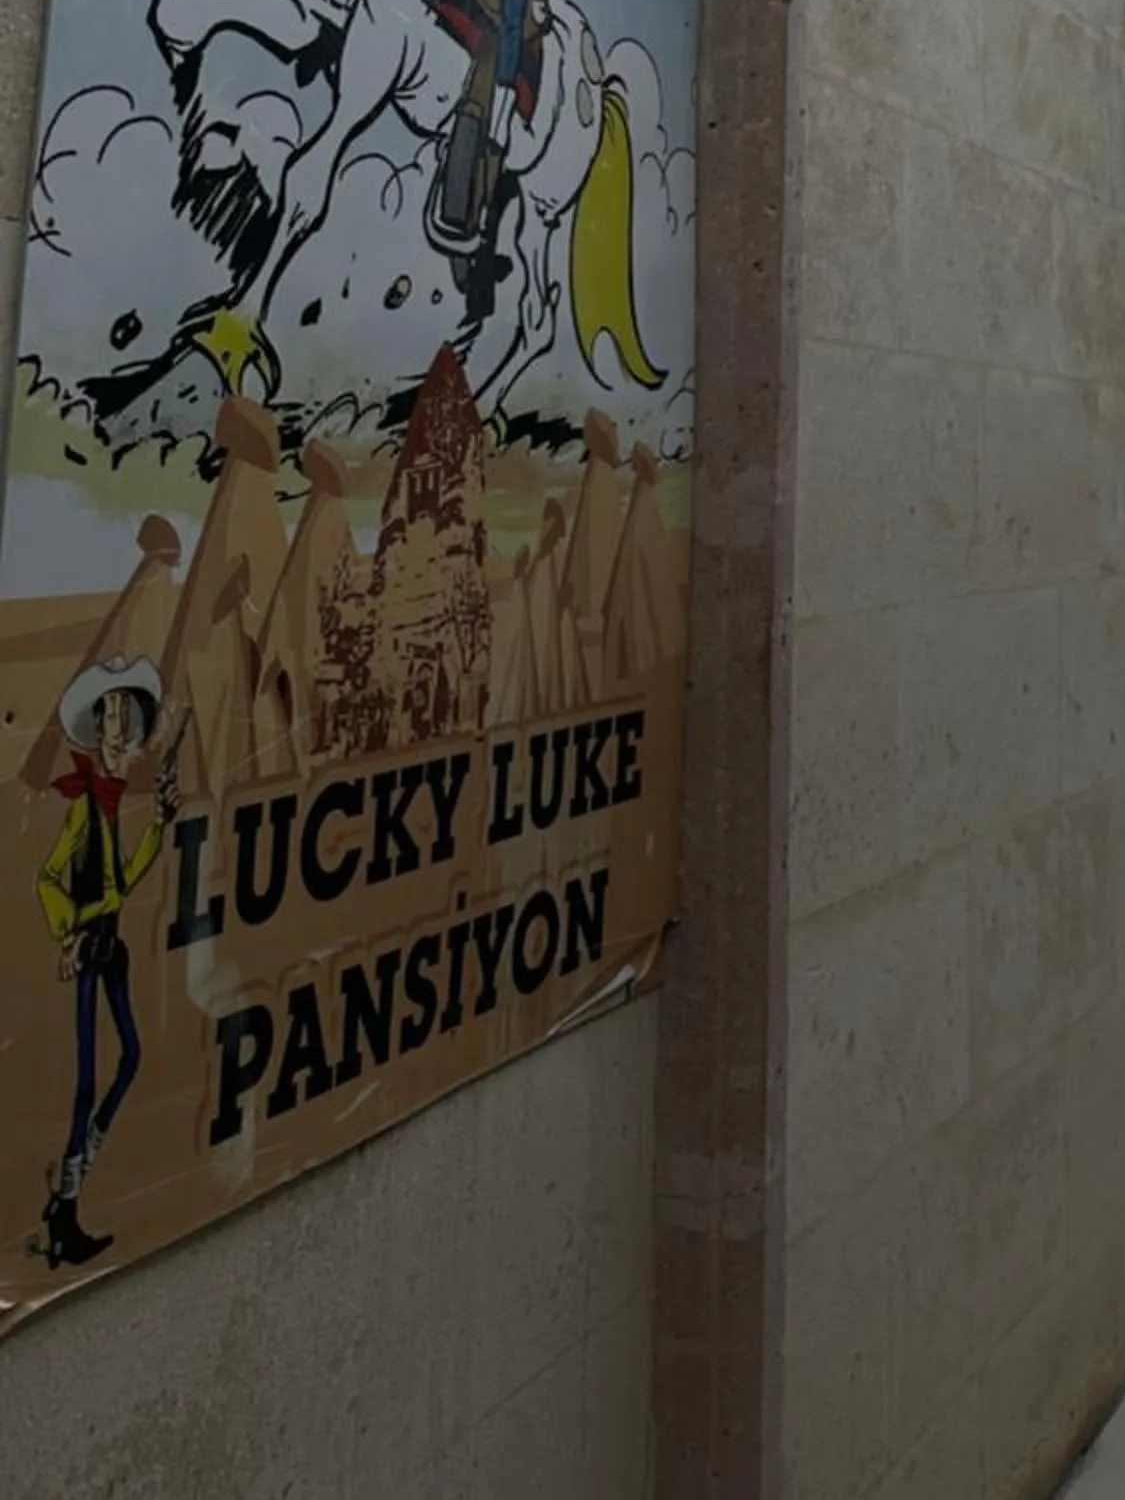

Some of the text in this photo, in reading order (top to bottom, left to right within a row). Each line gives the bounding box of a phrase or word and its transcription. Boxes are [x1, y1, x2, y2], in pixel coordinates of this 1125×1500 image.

[166, 709, 646, 951] LUCKY LUKE
[209, 867, 609, 1146] PANSİYON
